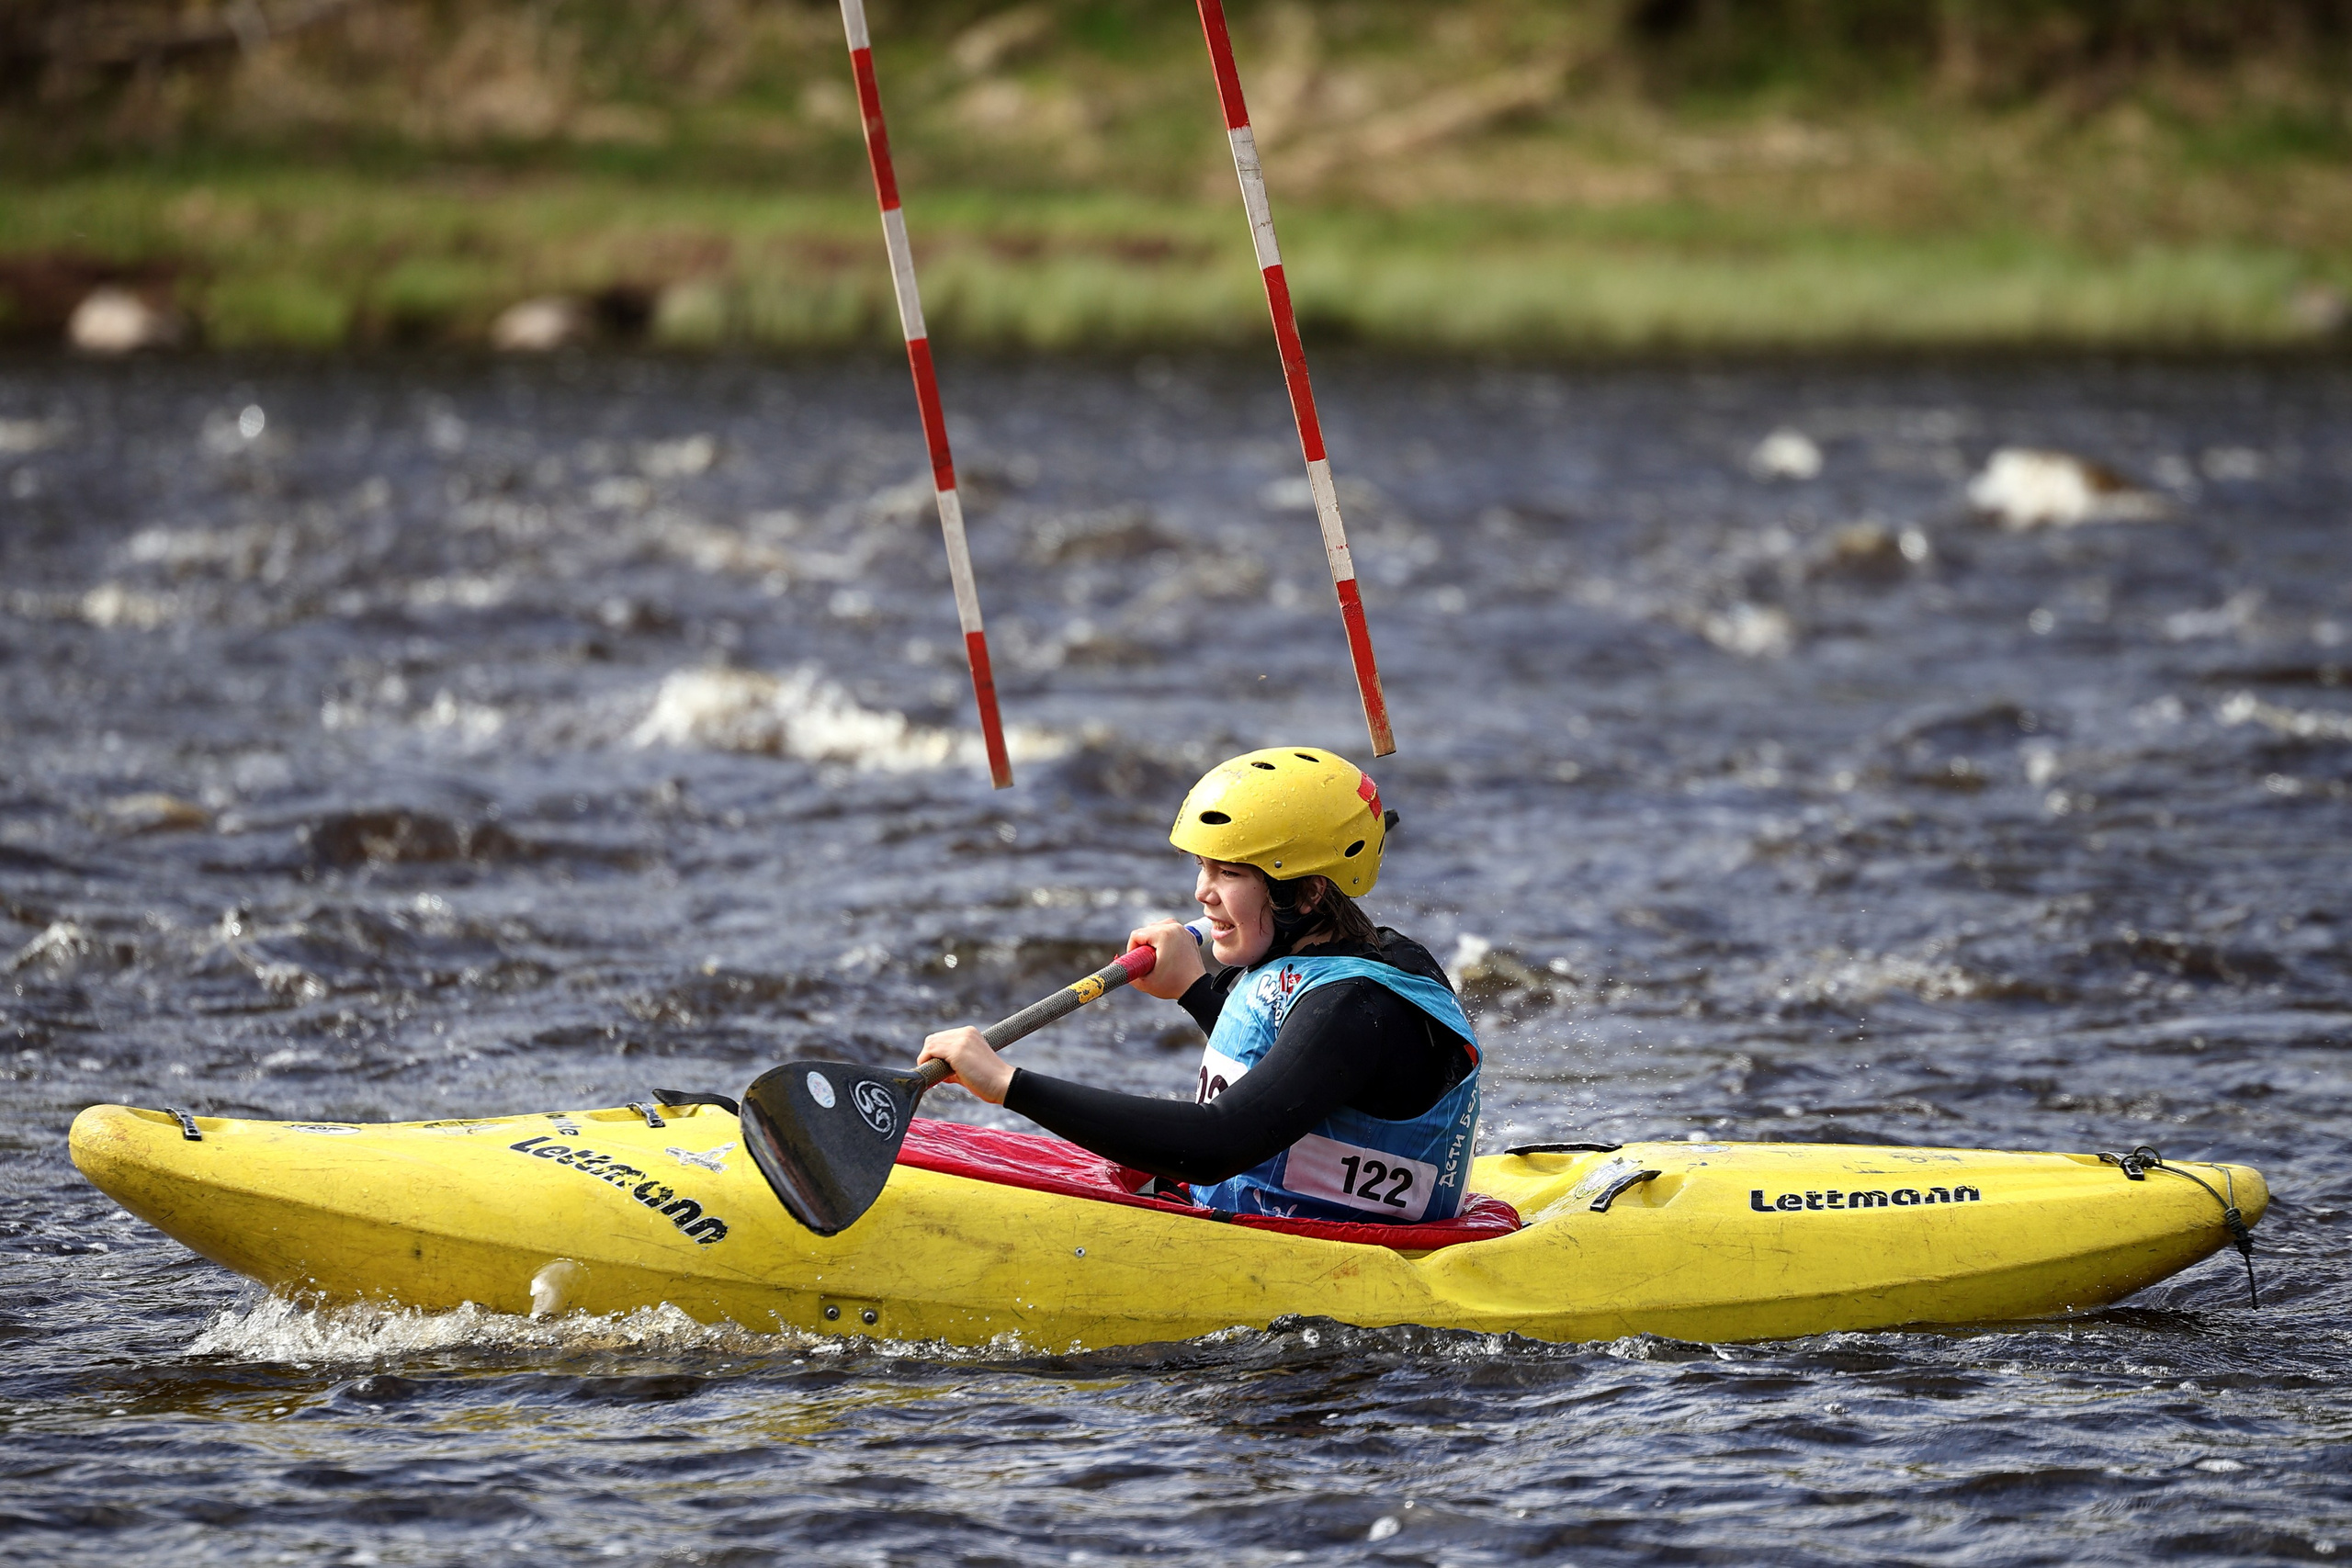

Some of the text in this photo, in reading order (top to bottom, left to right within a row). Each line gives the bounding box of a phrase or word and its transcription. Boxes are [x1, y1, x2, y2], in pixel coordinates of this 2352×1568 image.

[1341, 1156, 1413, 1208] 122
[1439, 1134, 1465, 1188] Дети
[509, 1136, 729, 1245] Lettmann
[1749, 1185, 1981, 1213] Lettmann
